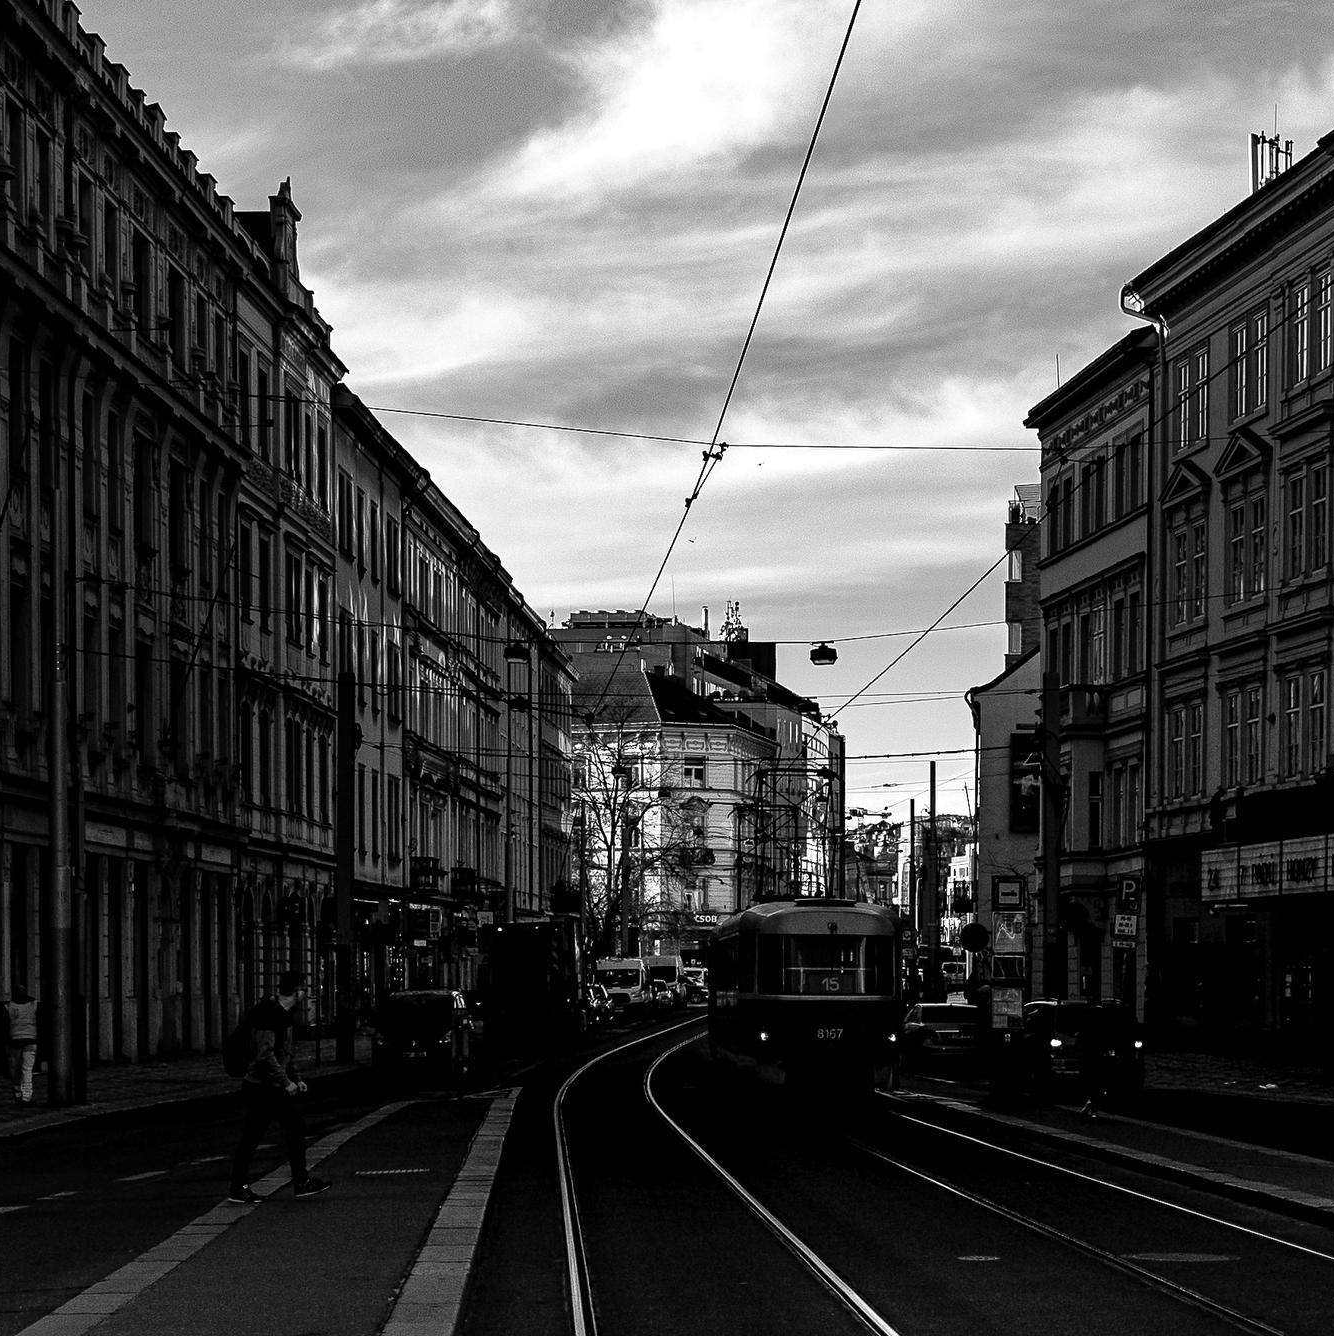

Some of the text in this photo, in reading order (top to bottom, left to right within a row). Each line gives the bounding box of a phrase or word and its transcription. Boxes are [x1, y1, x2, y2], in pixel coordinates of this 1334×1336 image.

[1121, 880, 1137, 900] P
[821, 977, 840, 992] 15
[816, 1028, 844, 1040] 8167
